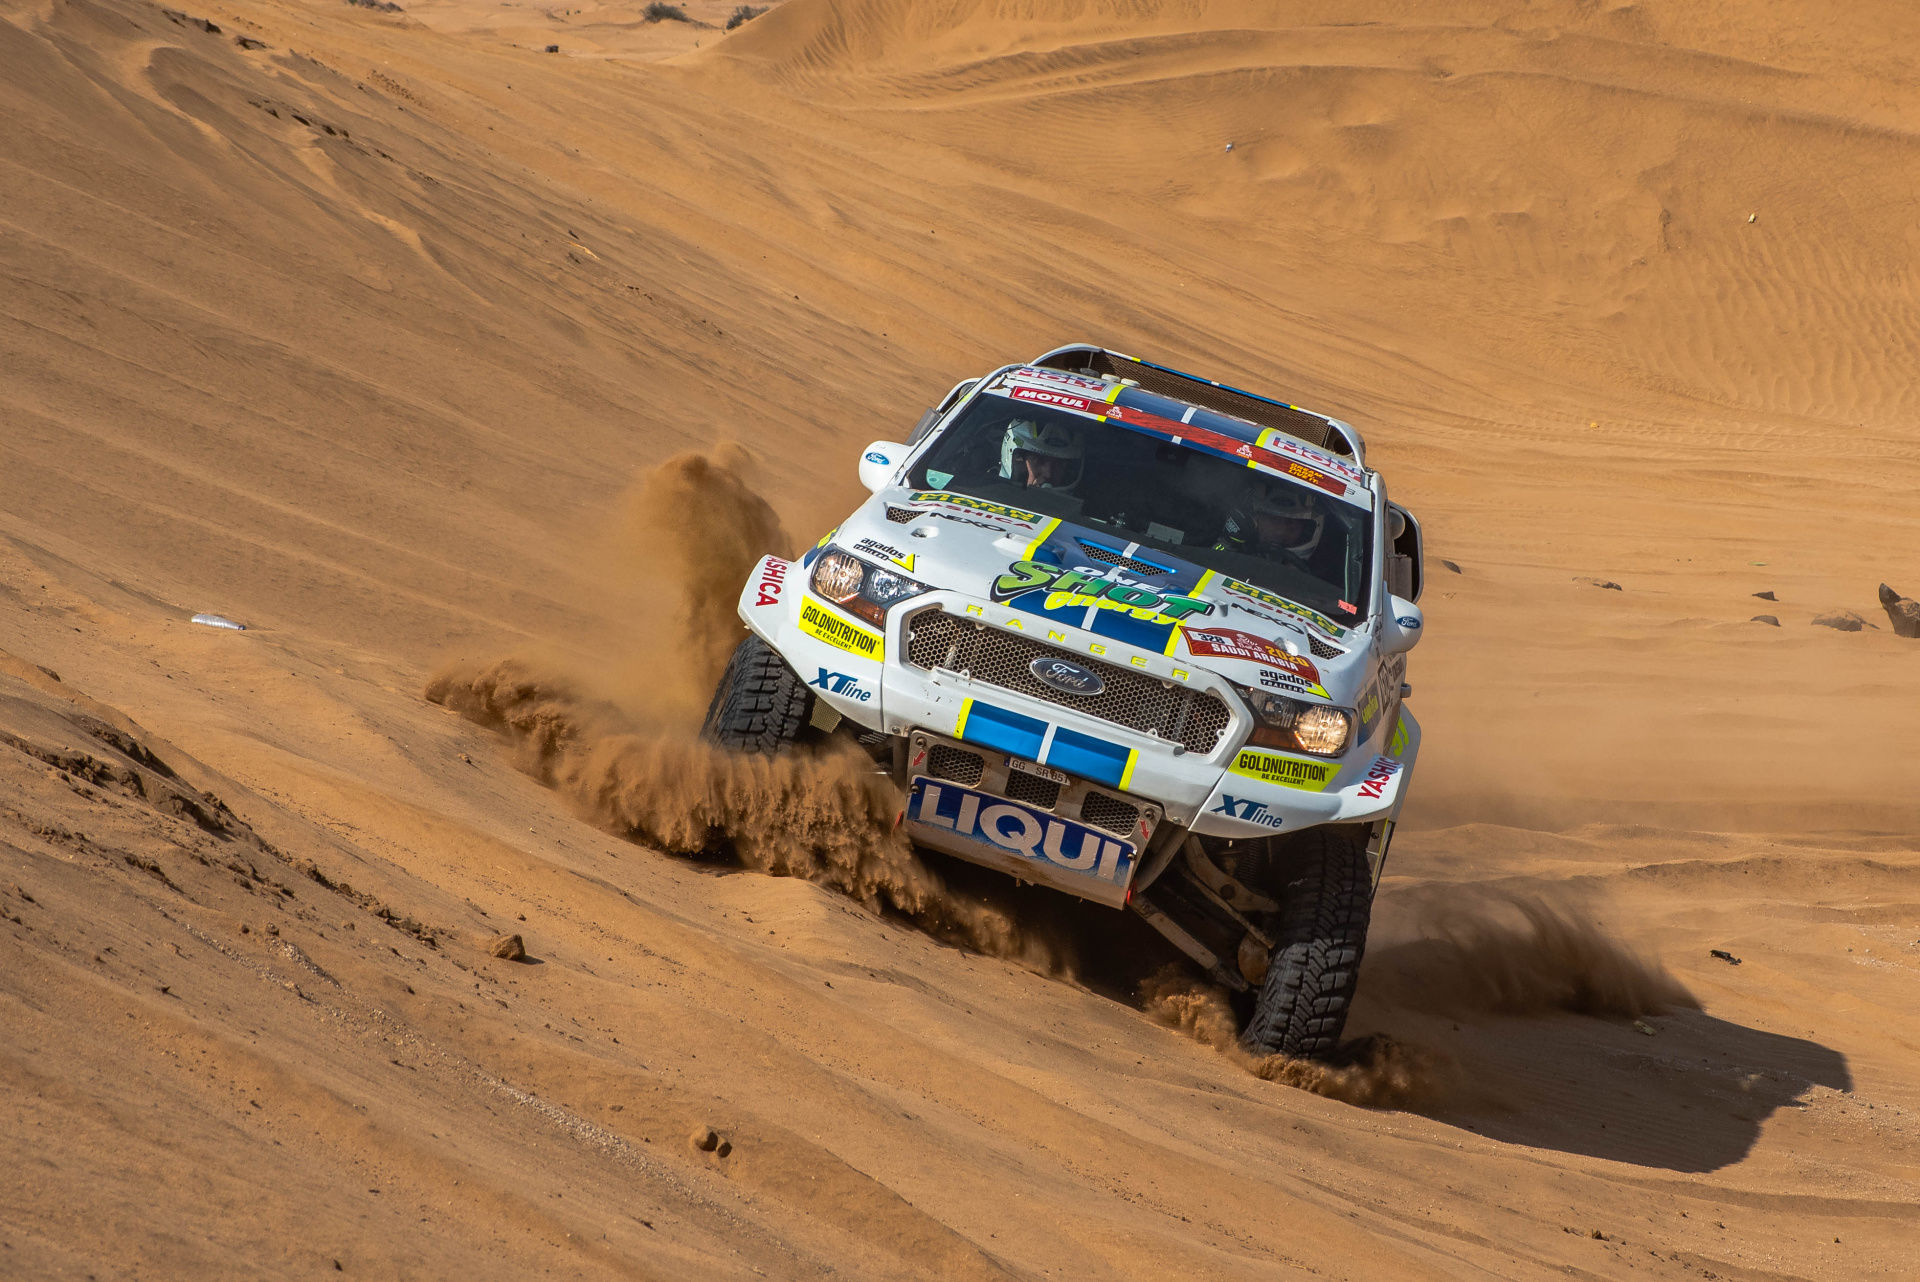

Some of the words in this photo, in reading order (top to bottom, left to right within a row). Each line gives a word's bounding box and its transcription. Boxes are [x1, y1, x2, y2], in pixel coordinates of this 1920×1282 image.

[1018, 390, 1084, 408] MOTUL
[909, 502, 1034, 530] YASHICA
[929, 512, 1006, 532] NEXO
[860, 537, 906, 559] agados
[990, 560, 1215, 621] SHOT
[802, 605, 878, 654] GOLDNUTRITION
[1221, 587, 1341, 644] YASHICA
[1231, 602, 1304, 634] NEXO
[823, 632, 852, 650] EXCELLENT
[966, 603, 1189, 682] RANGER
[1198, 633, 1226, 644] 328
[1211, 643, 1251, 657] SAUDI
[1253, 651, 1299, 671] ARABIA
[1265, 645, 1309, 667] 2020
[807, 667, 872, 702] XTline
[1046, 663, 1089, 688] Ford
[1260, 669, 1313, 688] agados
[1012, 760, 1026, 771] GG
[1239, 753, 1326, 782] GOLDNUTRITION
[1271, 774, 1305, 786] EXCELLENT
[1210, 794, 1283, 828] XTline
[919, 784, 1122, 880] LIQUI
